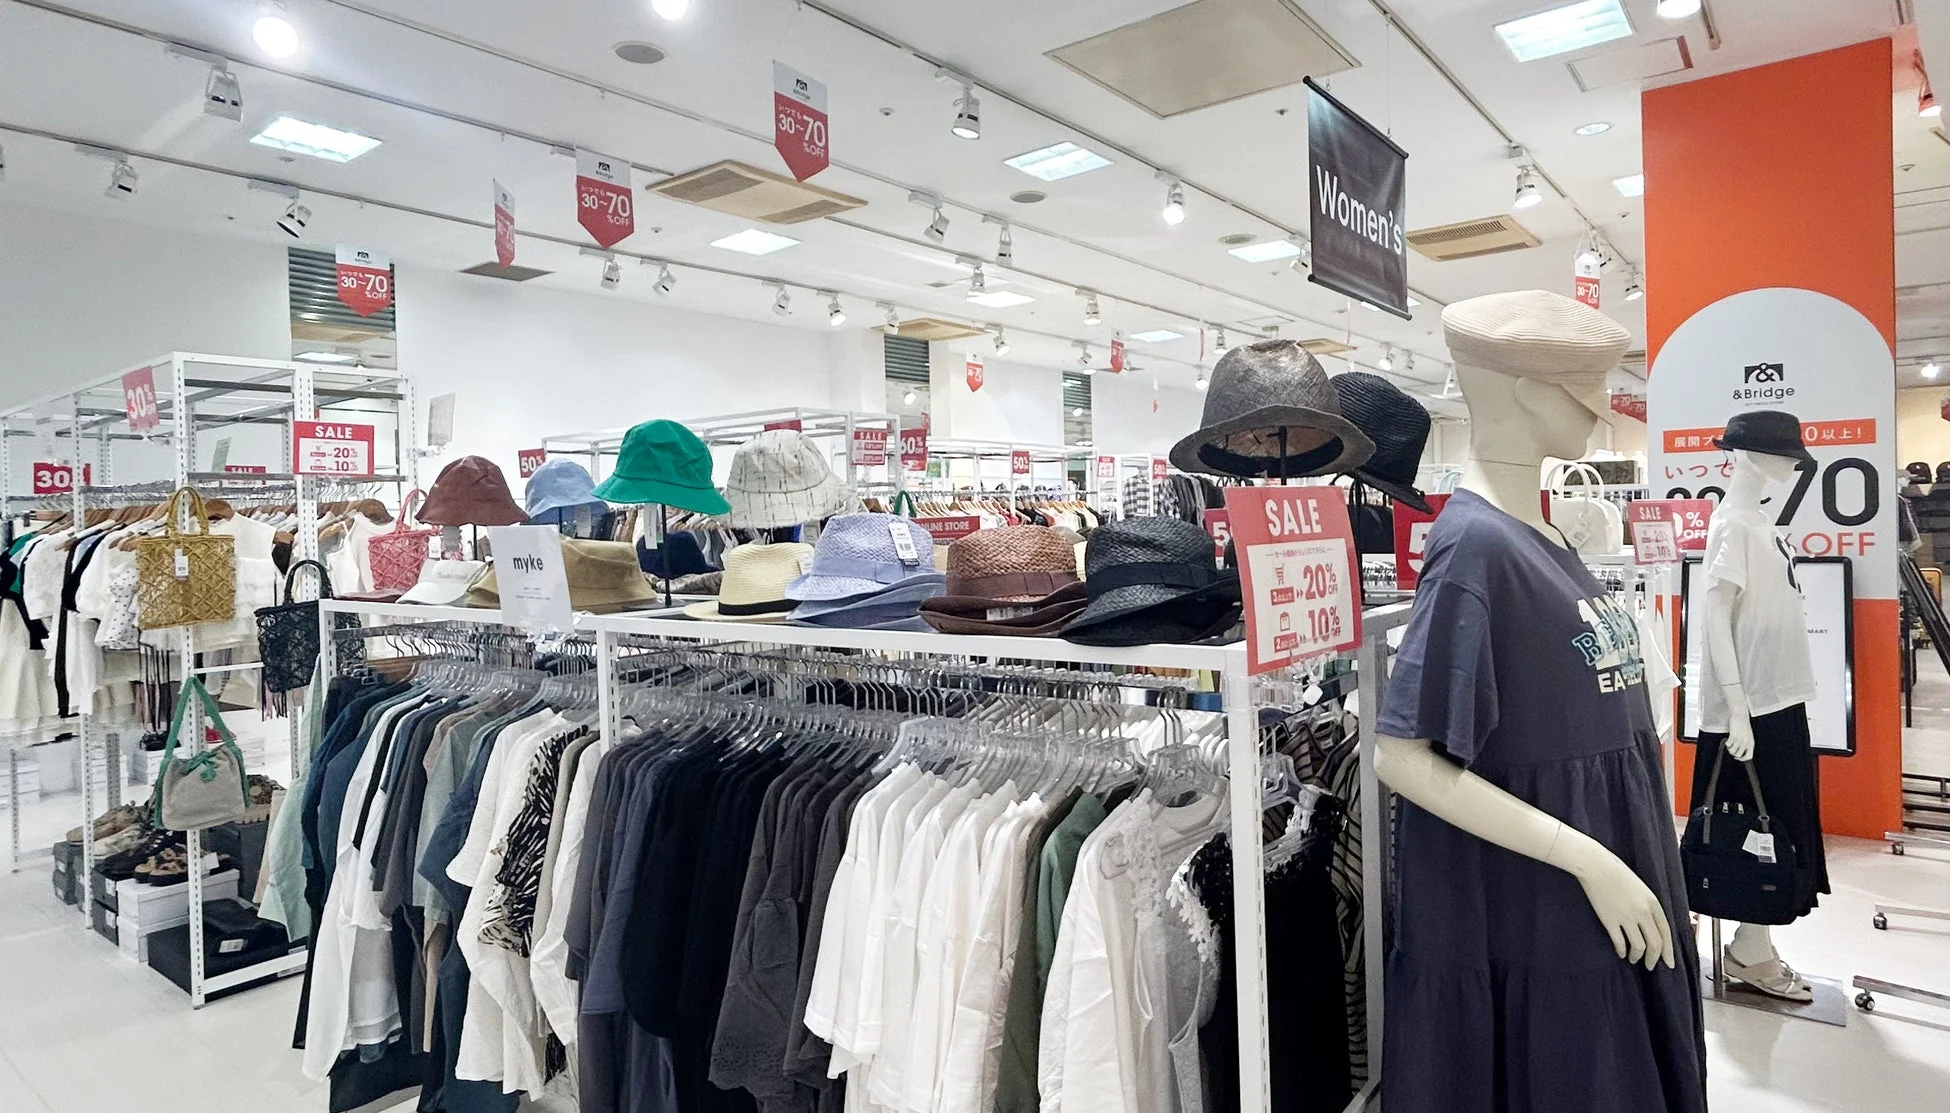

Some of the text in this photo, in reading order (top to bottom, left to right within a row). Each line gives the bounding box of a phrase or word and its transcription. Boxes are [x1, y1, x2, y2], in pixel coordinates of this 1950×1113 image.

[1316, 164, 1402, 255] Women's
[1732, 386, 1795, 400] &Bridge
[315, 426, 353, 439] SALE
[860, 432, 882, 440] SALE
[1265, 498, 1322, 536] SALE
[1640, 506, 1662, 520] SALE
[944, 521, 970, 531] STORE
[1683, 529, 1708, 540] OFF
[512, 553, 544, 573] myke
[1328, 583, 1338, 595] OFF
